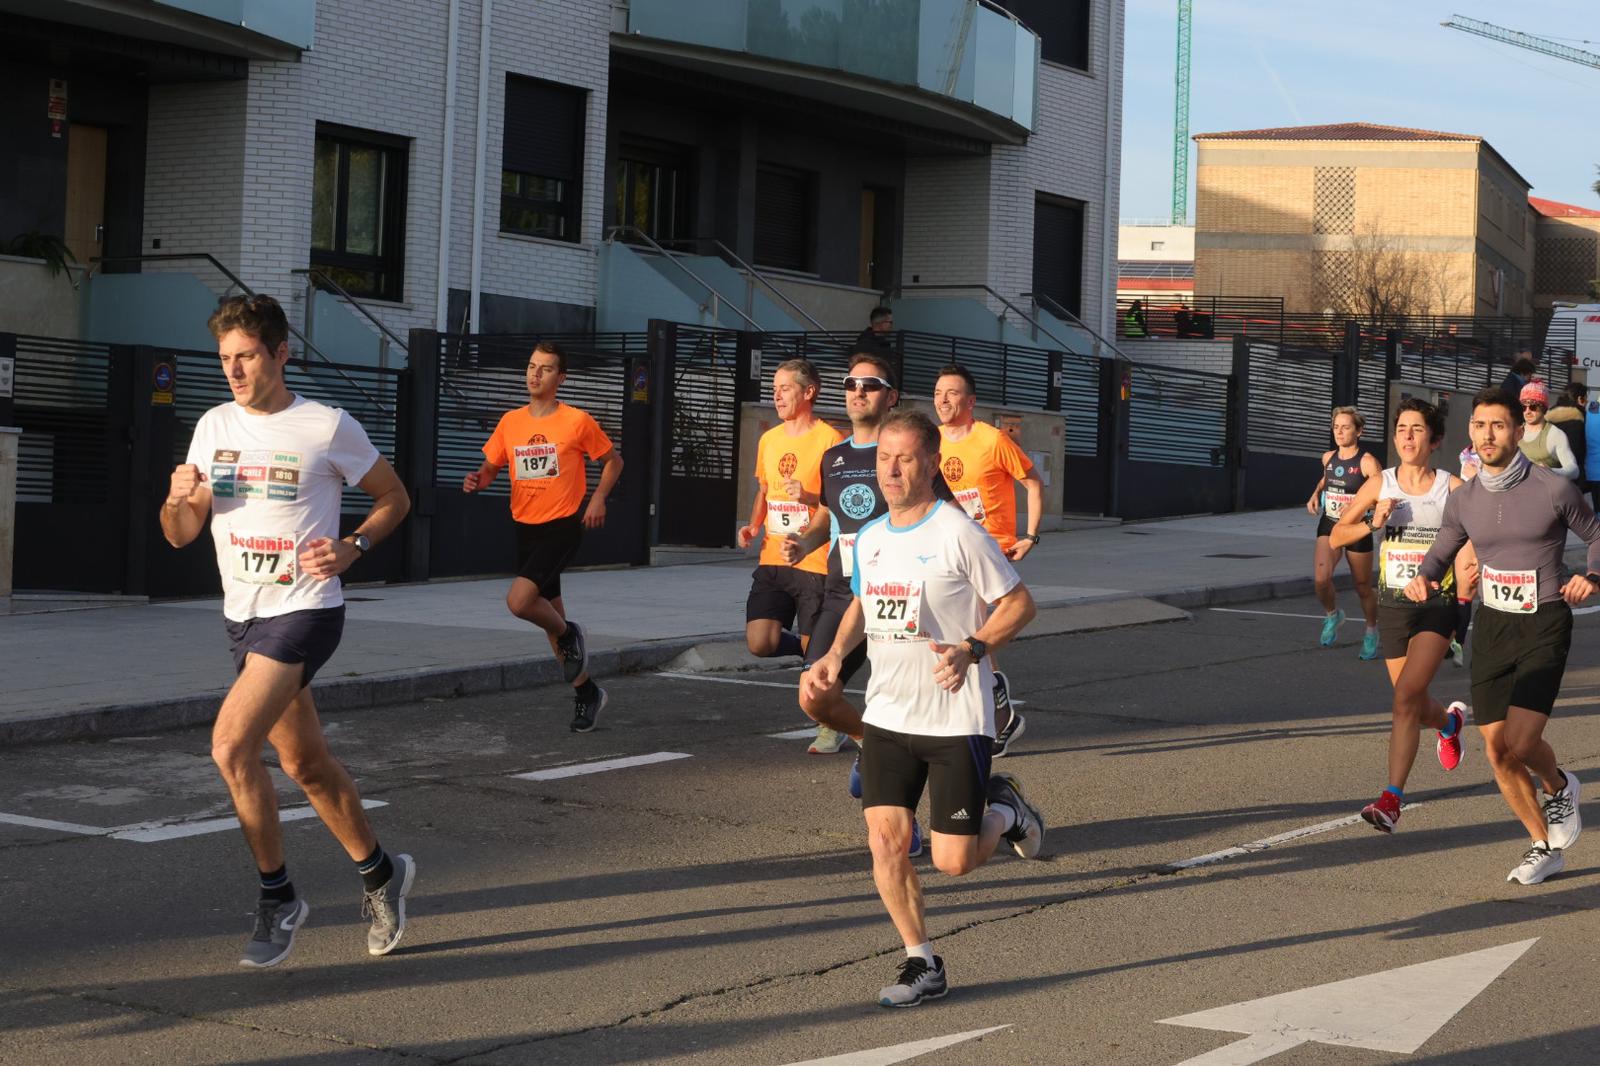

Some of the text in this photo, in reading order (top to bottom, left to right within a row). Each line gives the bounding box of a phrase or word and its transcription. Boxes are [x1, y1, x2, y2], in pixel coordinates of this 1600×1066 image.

[523, 456, 548, 471] 187
[781, 513, 791, 526] 5
[230, 532, 294, 551] bedunia
[241, 551, 280, 574] 177
[1483, 568, 1535, 584] bedunia
[1491, 584, 1524, 602] 194
[876, 599, 907, 620] 227
